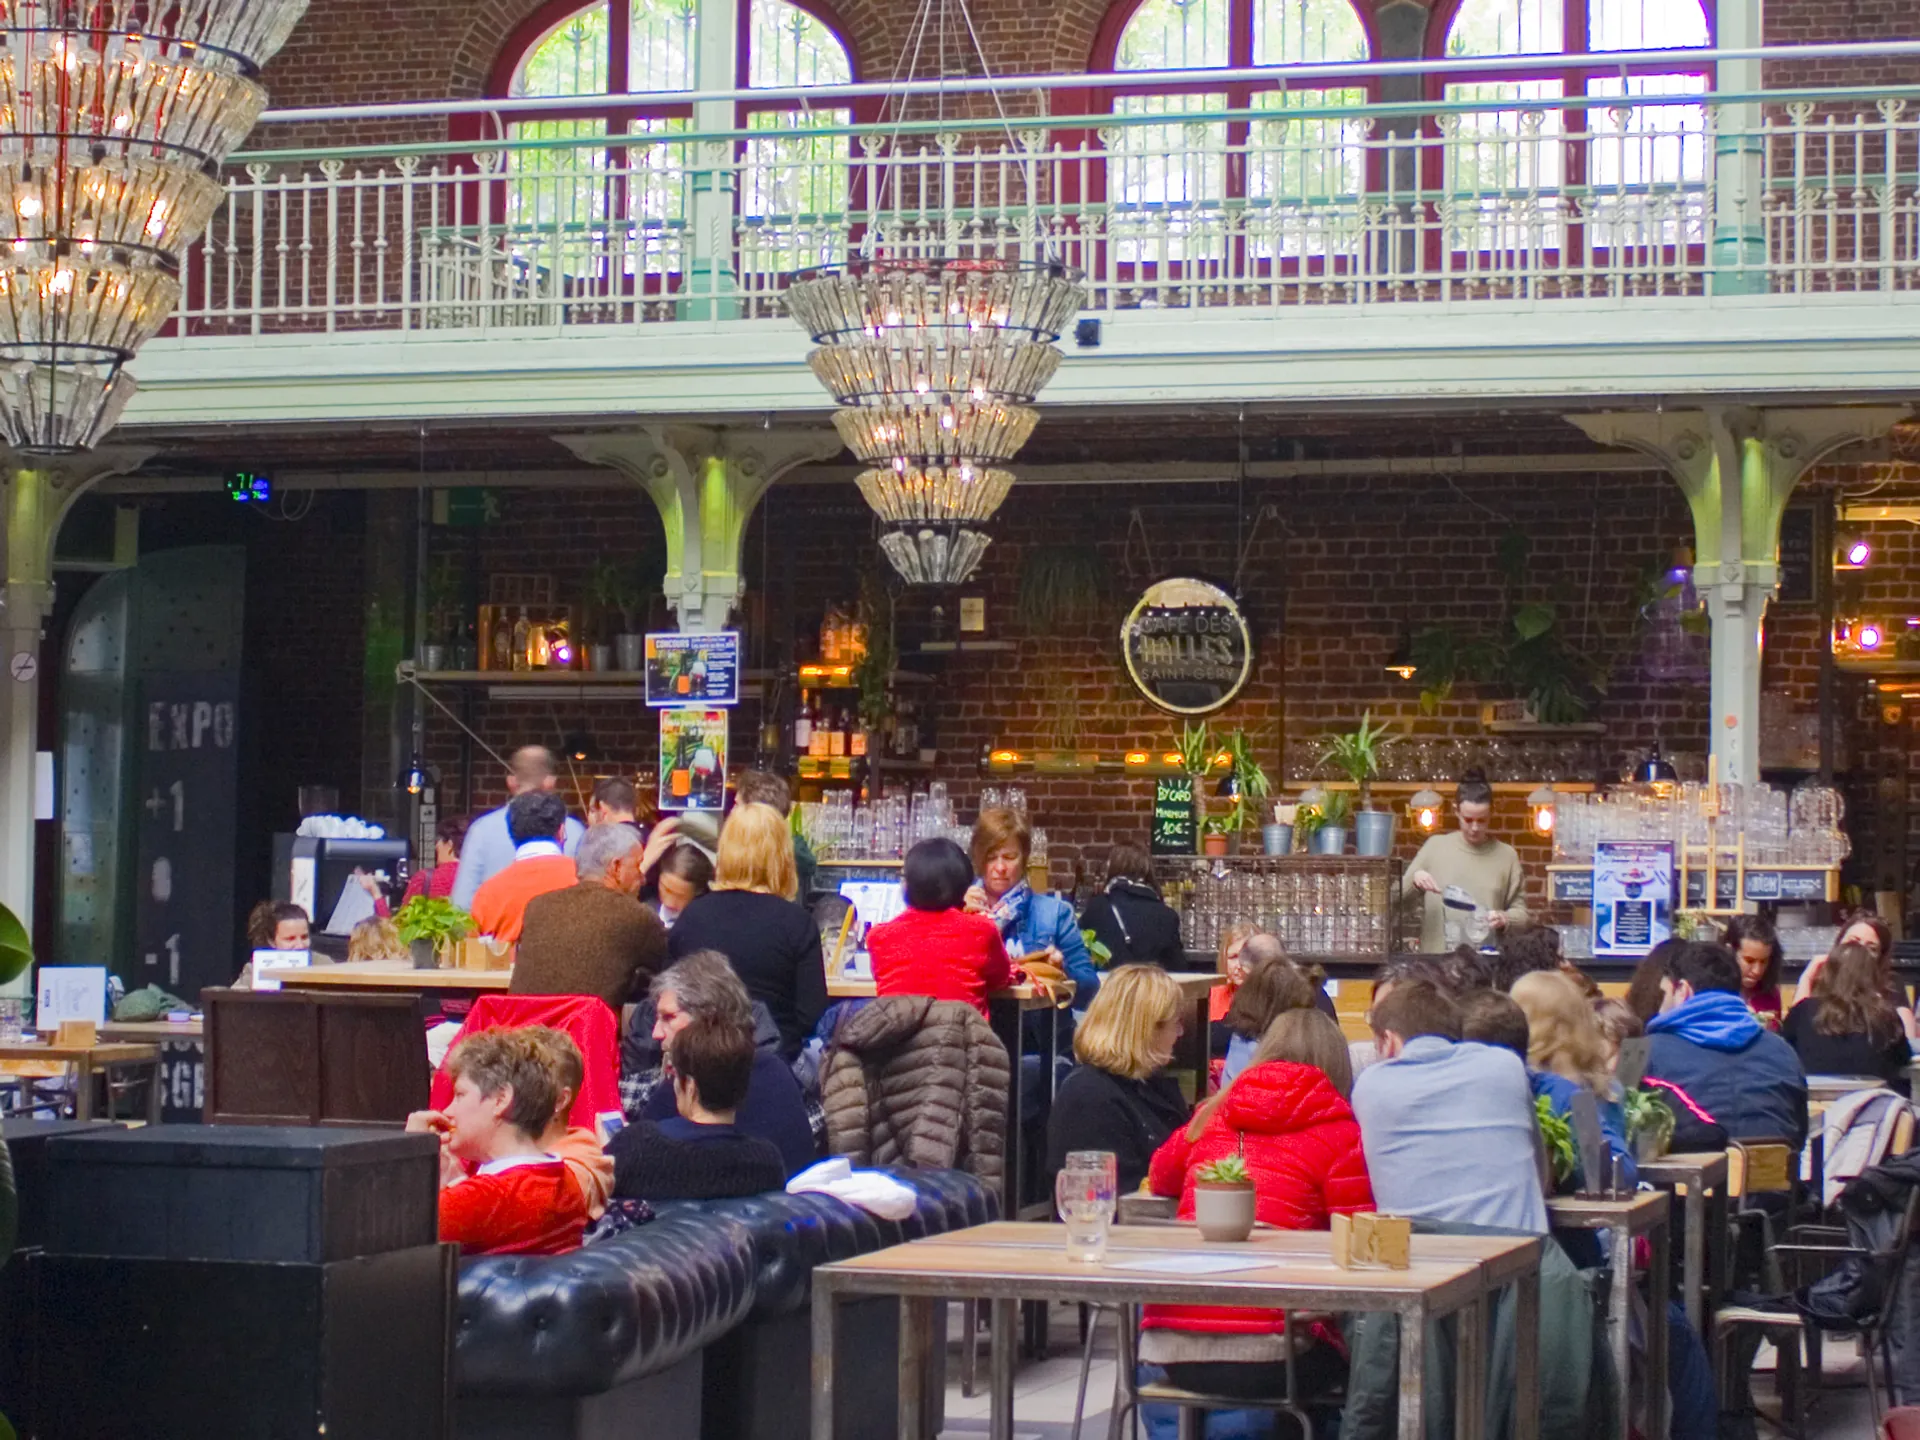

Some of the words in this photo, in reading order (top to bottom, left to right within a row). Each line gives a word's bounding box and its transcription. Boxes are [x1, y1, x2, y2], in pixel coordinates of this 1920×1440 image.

[1195, 615, 1231, 634] DES
[1139, 634, 1234, 666] HALLES
[148, 701, 234, 752] EXPO
